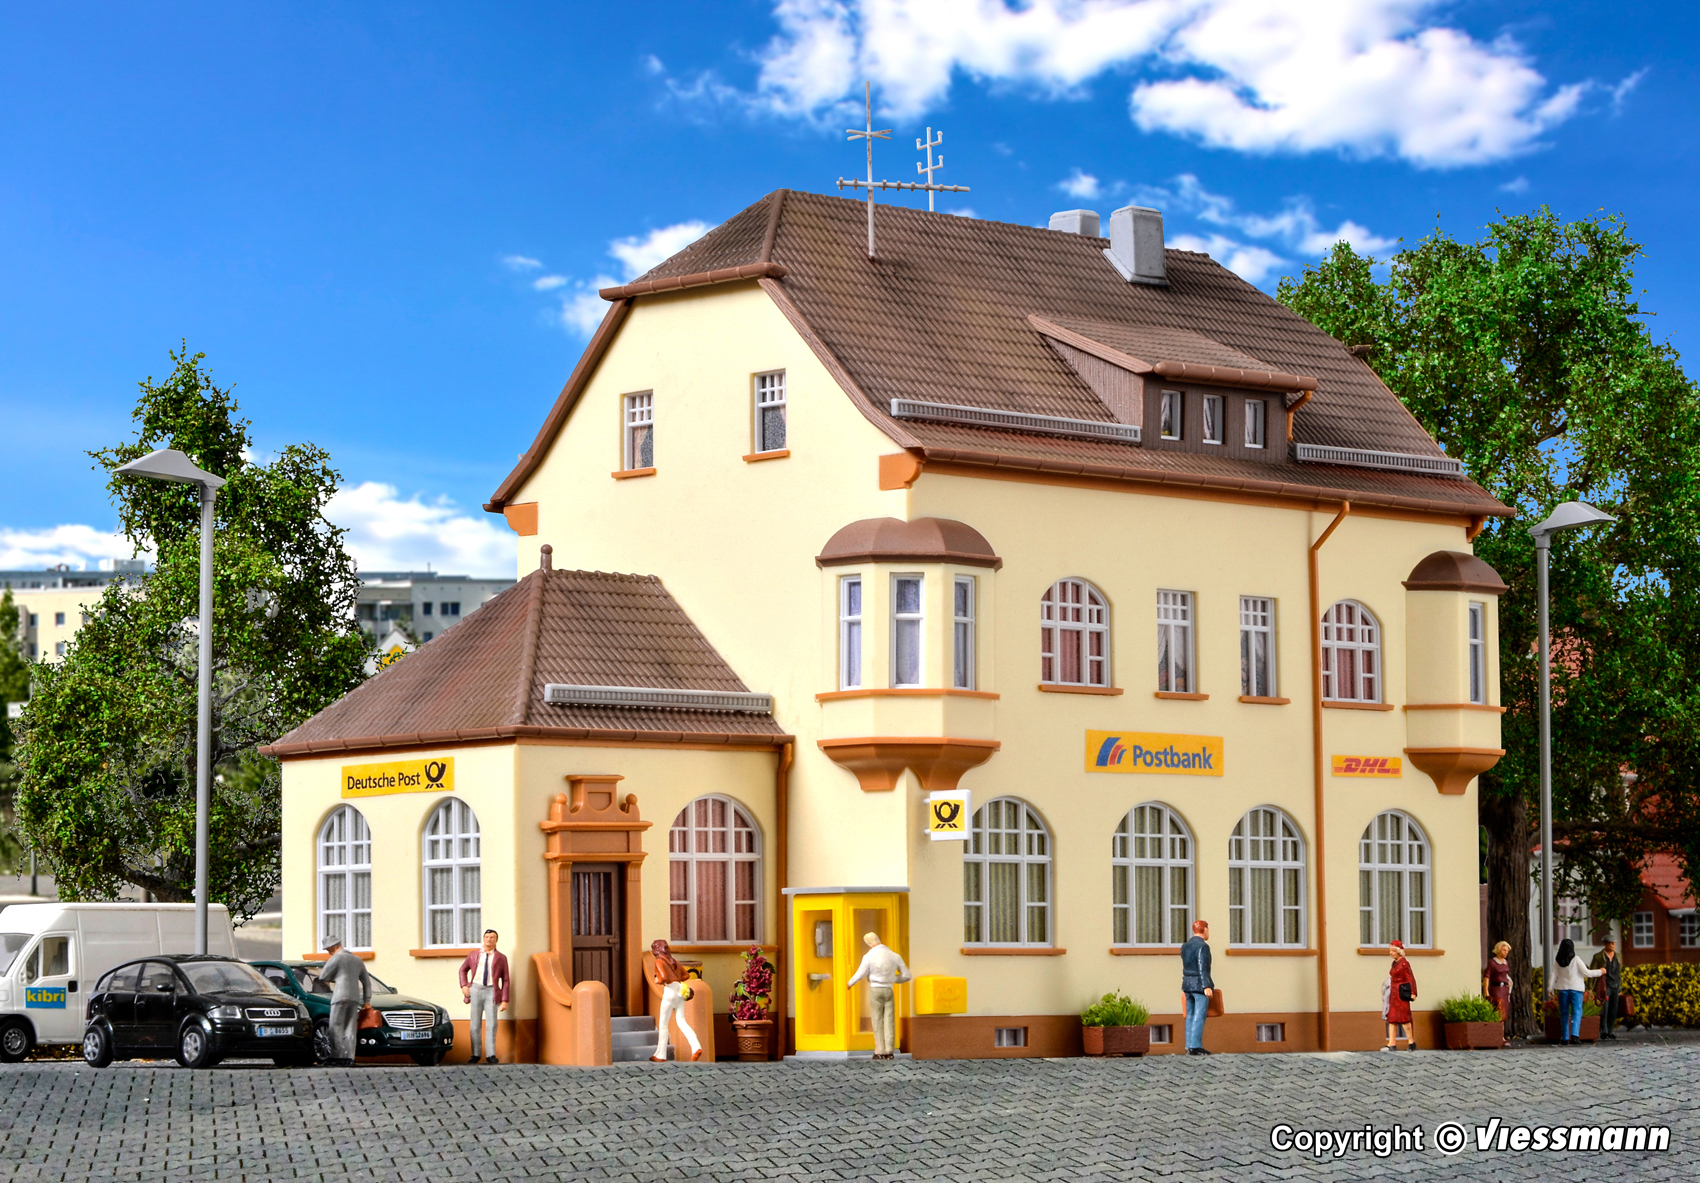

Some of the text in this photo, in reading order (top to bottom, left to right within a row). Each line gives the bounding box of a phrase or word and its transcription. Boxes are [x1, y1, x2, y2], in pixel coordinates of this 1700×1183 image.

[1133, 745, 1213, 770] Postbank
[1343, 757, 1391, 774] DHL
[347, 772, 421, 790] Deutsche Post
[27, 989, 65, 1003] kibri
